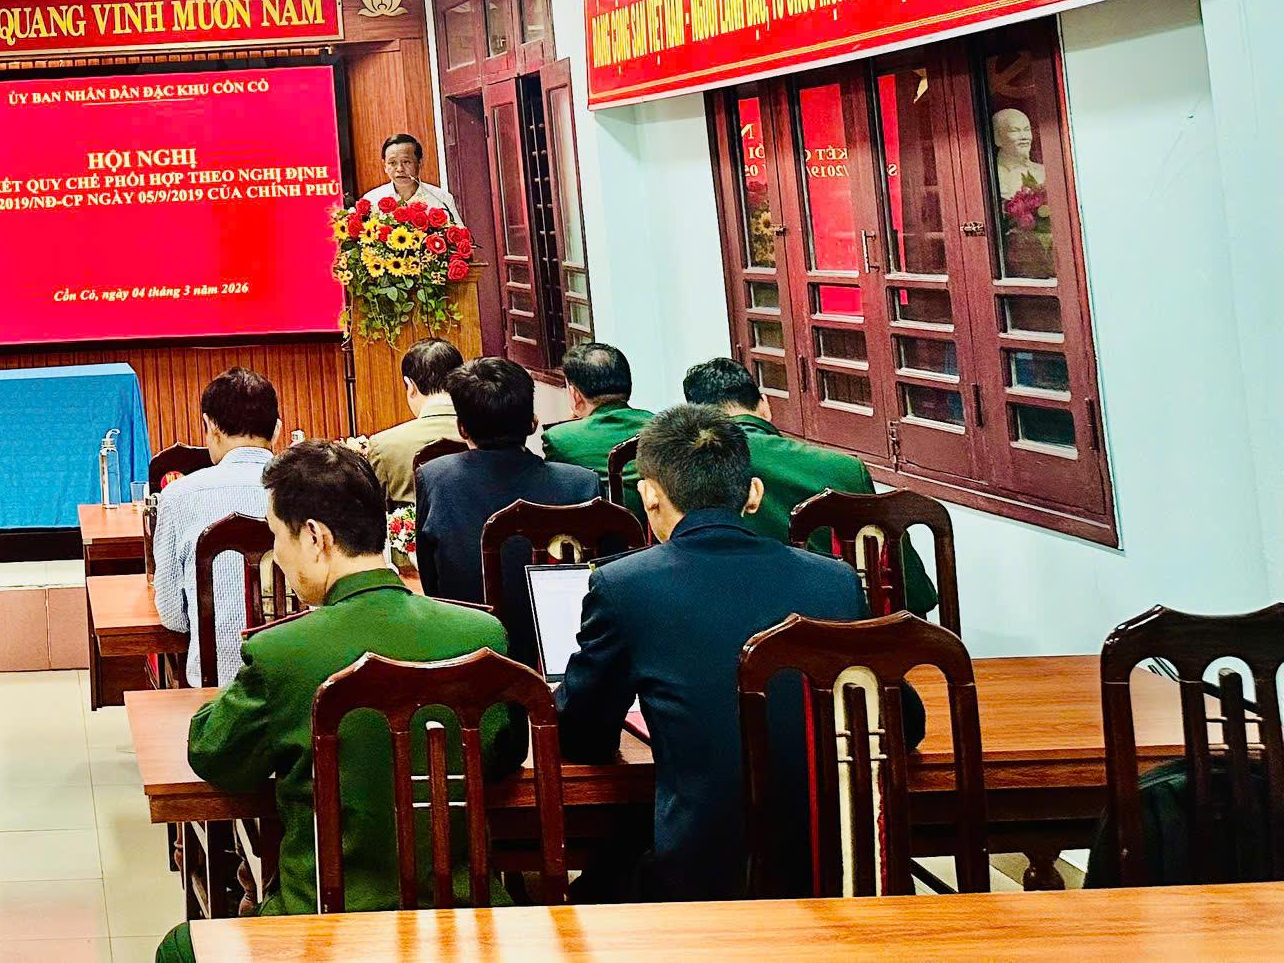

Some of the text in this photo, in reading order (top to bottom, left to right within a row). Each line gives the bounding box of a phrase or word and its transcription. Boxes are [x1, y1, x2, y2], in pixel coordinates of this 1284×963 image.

[91, 0, 166, 35] VINH
[32, 91, 61, 104] BAN
[65, 86, 106, 102] NHÂN
[109, 84, 140, 100] DÂN
[143, 85, 175, 100] ĐẶC
[177, 83, 209, 97] KHU
[247, 78, 269, 92] CỎ
[87, 148, 198, 173] HỘI NGHỊ
[26, 179, 62, 193] QUY
[65, 173, 101, 190] CHẾ
[104, 171, 145, 187] PHỐI
[149, 172, 184, 187] HỢP
[188, 169, 235, 184] THEO
[238, 168, 281, 184] NGHỊ
[285, 166, 328, 182] ĐỊNH
[87, 190, 134, 206] NGÀY
[138, 188, 204, 204] 05/9/2019
[207, 185, 242, 200] CỦA
[246, 182, 301, 198] CHÍNH
[305, 179, 340, 197] PHỦ
[54, 288, 77, 302] Cồn
[102, 289, 129, 303] ngày
[132, 287, 145, 298] 04
[148, 286, 181, 299] tháng
[183, 285, 191, 296] 3
[193, 285, 218, 296] năm
[221, 282, 249, 294] 2026
